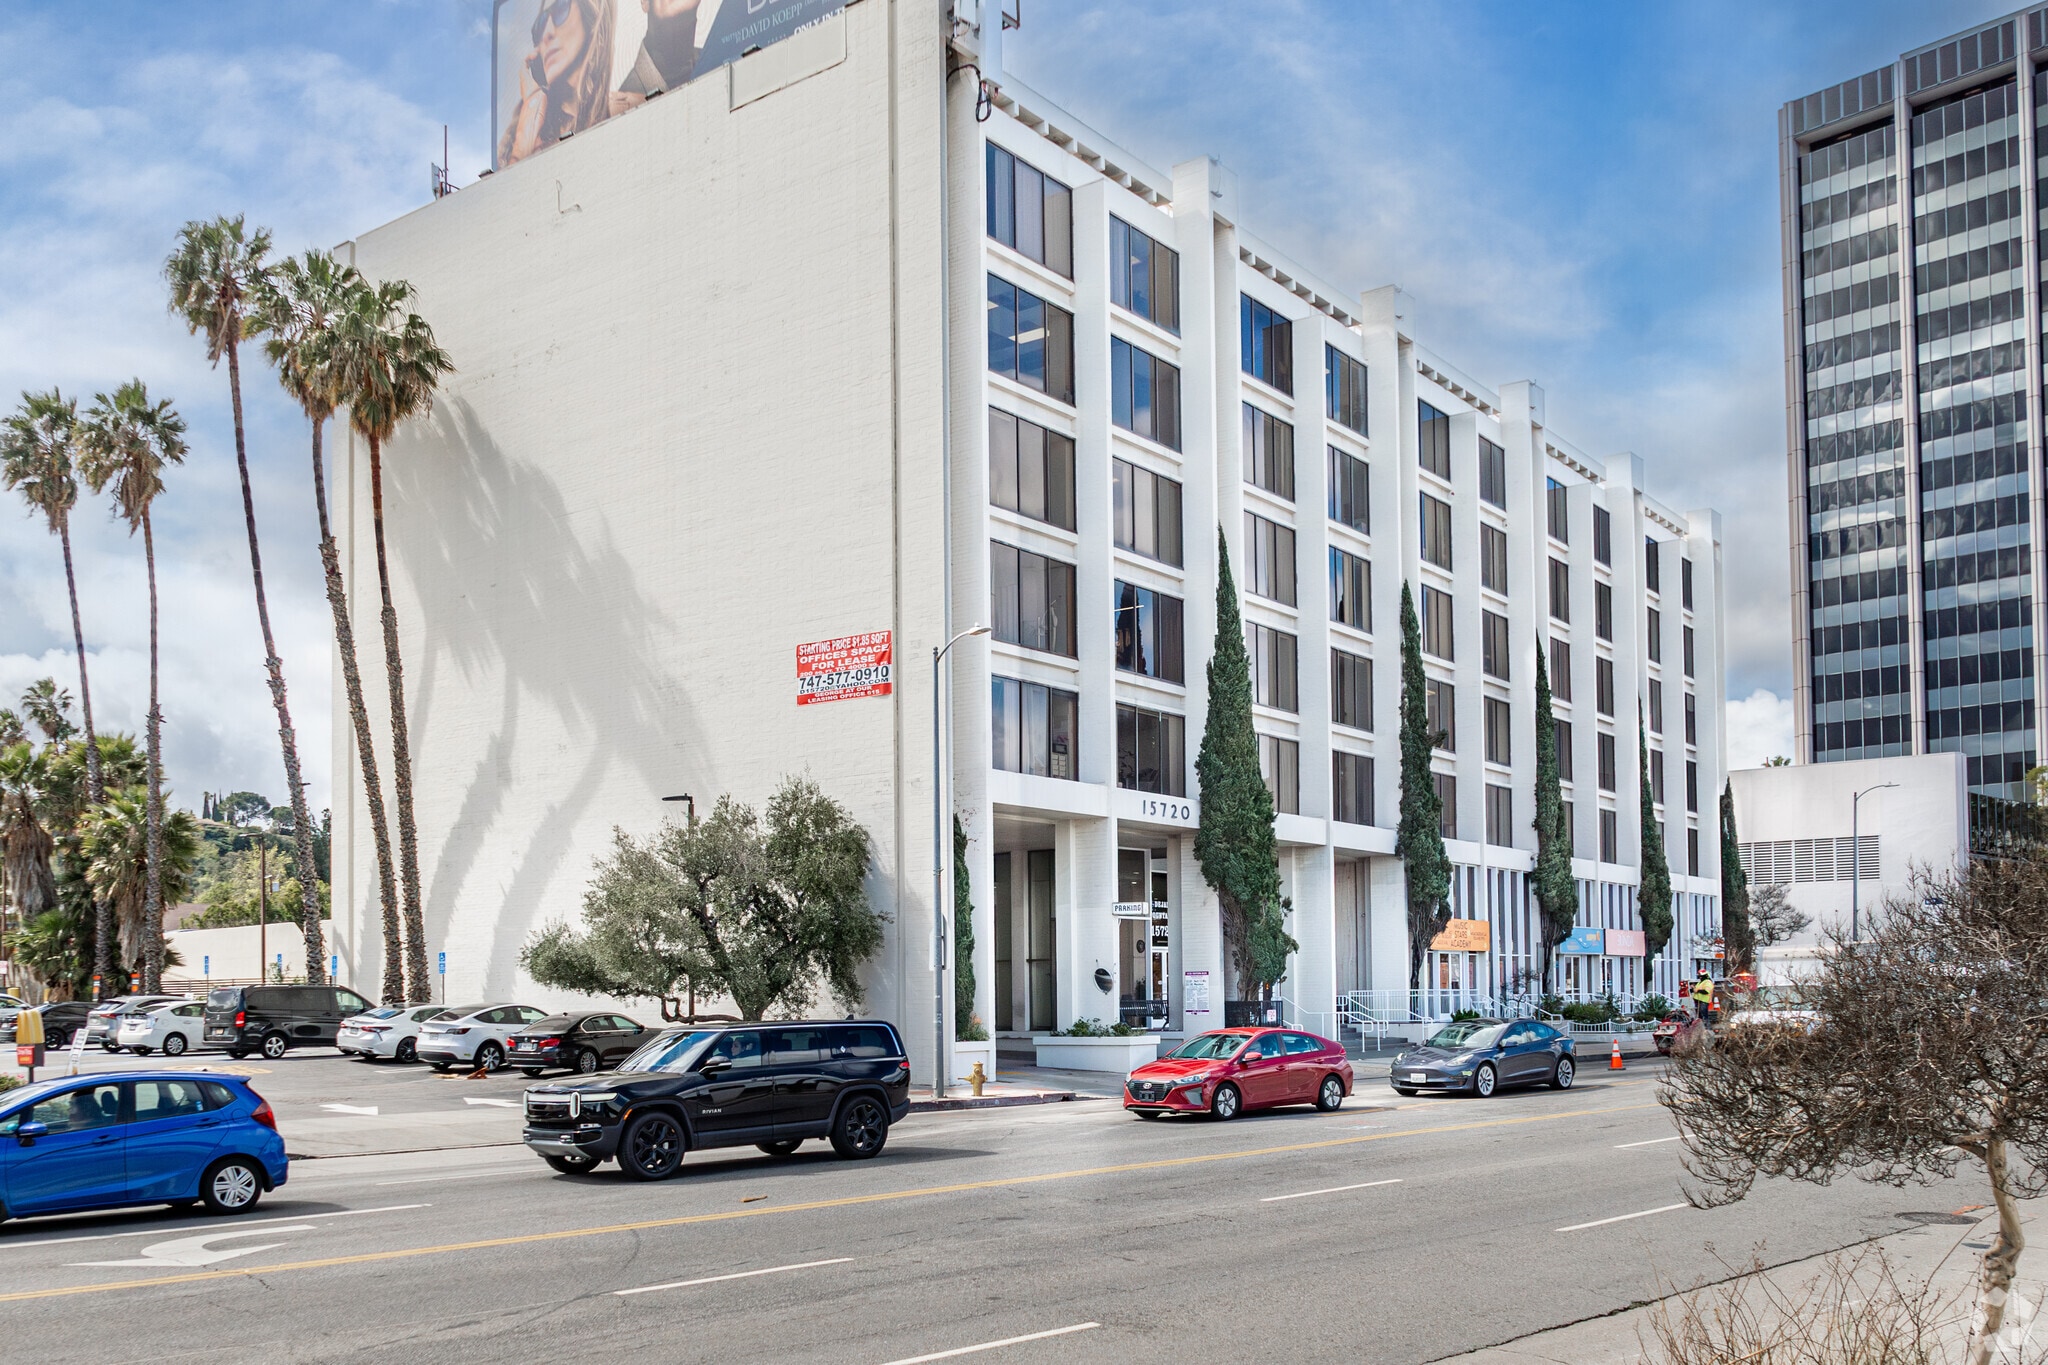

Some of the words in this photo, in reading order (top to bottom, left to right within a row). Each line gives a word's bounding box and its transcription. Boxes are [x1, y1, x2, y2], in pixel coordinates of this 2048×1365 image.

[741, 17, 771, 41] DAVID
[772, 3, 804, 28] KOEPP
[799, 650, 848, 664] OFFICES
[851, 643, 889, 657] SPACE
[800, 642, 831, 656] STARTING
[831, 637, 852, 651] PRICE
[852, 635, 870, 648] $1.85
[811, 660, 835, 671] FOR
[837, 654, 876, 667] LEASE
[799, 665, 889, 690] 747-577-0910
[807, 695, 838, 704] LEASING
[839, 691, 866, 699] OFFICE
[1143, 799, 1190, 821] 15720
[1114, 904, 1142, 912] PARKING
[1454, 930, 1468, 939] STARS
